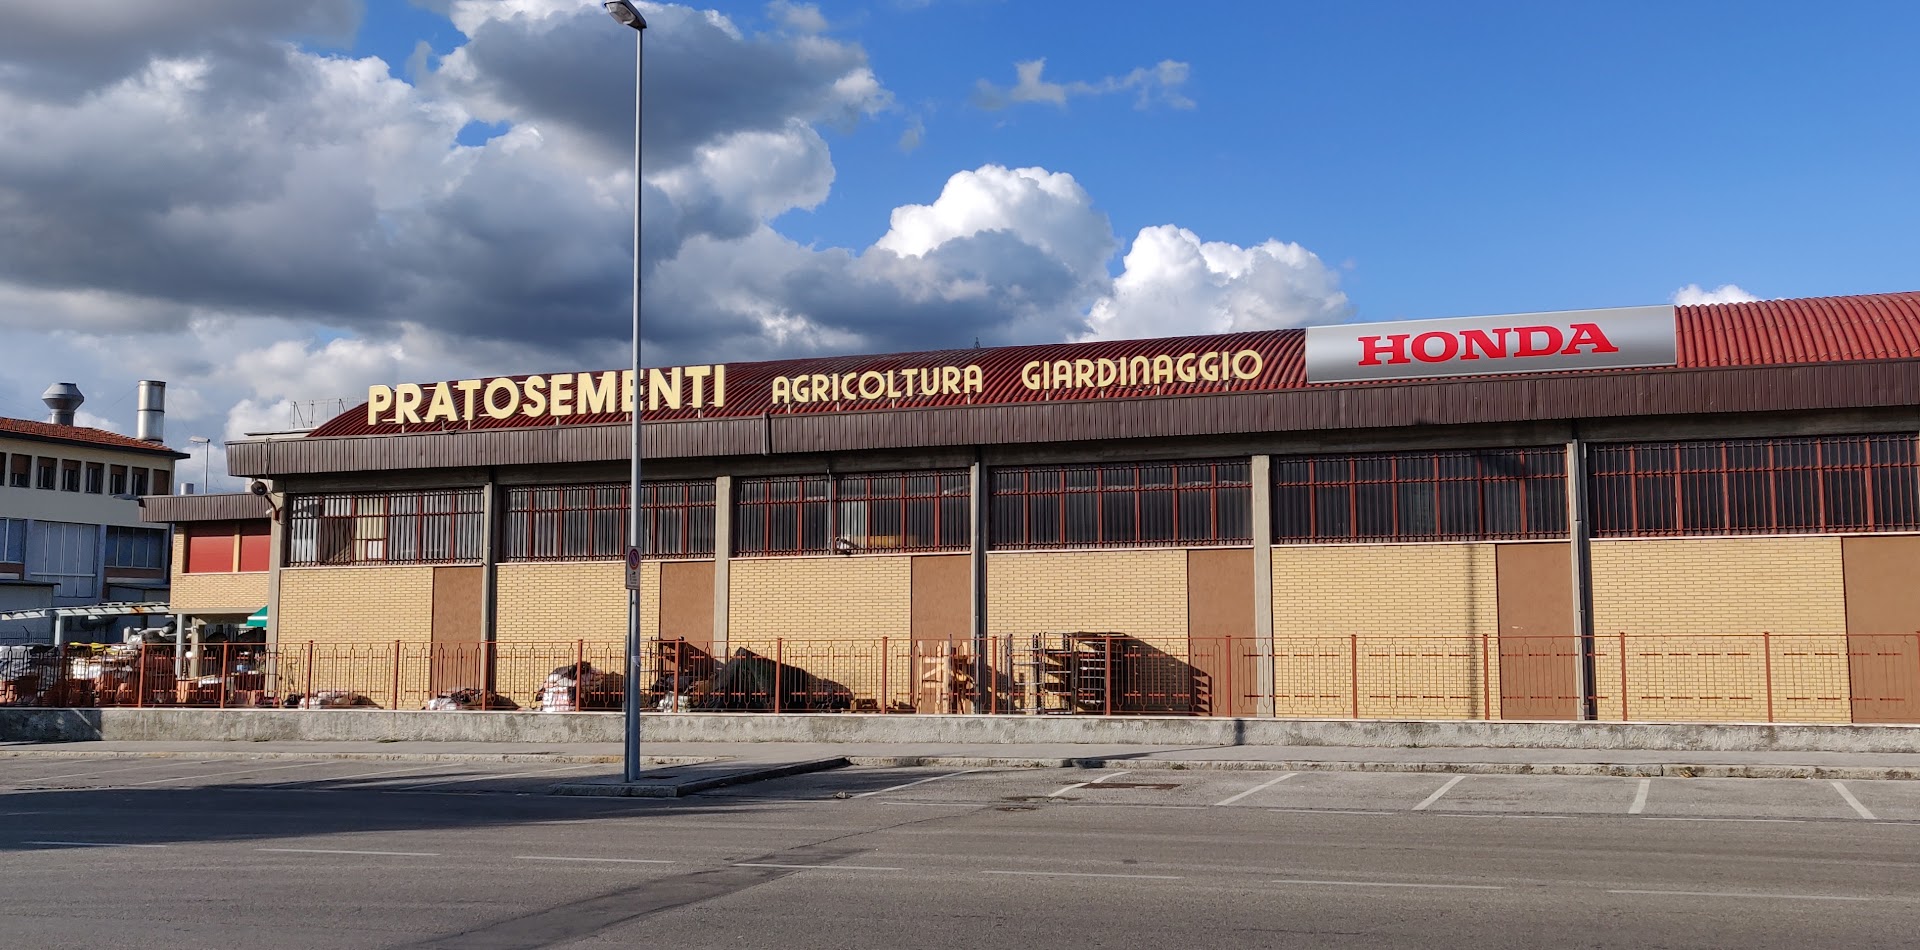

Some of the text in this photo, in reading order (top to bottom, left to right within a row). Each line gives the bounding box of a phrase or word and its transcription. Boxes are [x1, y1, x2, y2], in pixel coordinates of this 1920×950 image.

[1358, 323, 1619, 367] HONDA
[367, 364, 726, 426] PRATOSEMENTI
[772, 349, 1264, 404] AGRICOLTURA GIARDINAGGIO
